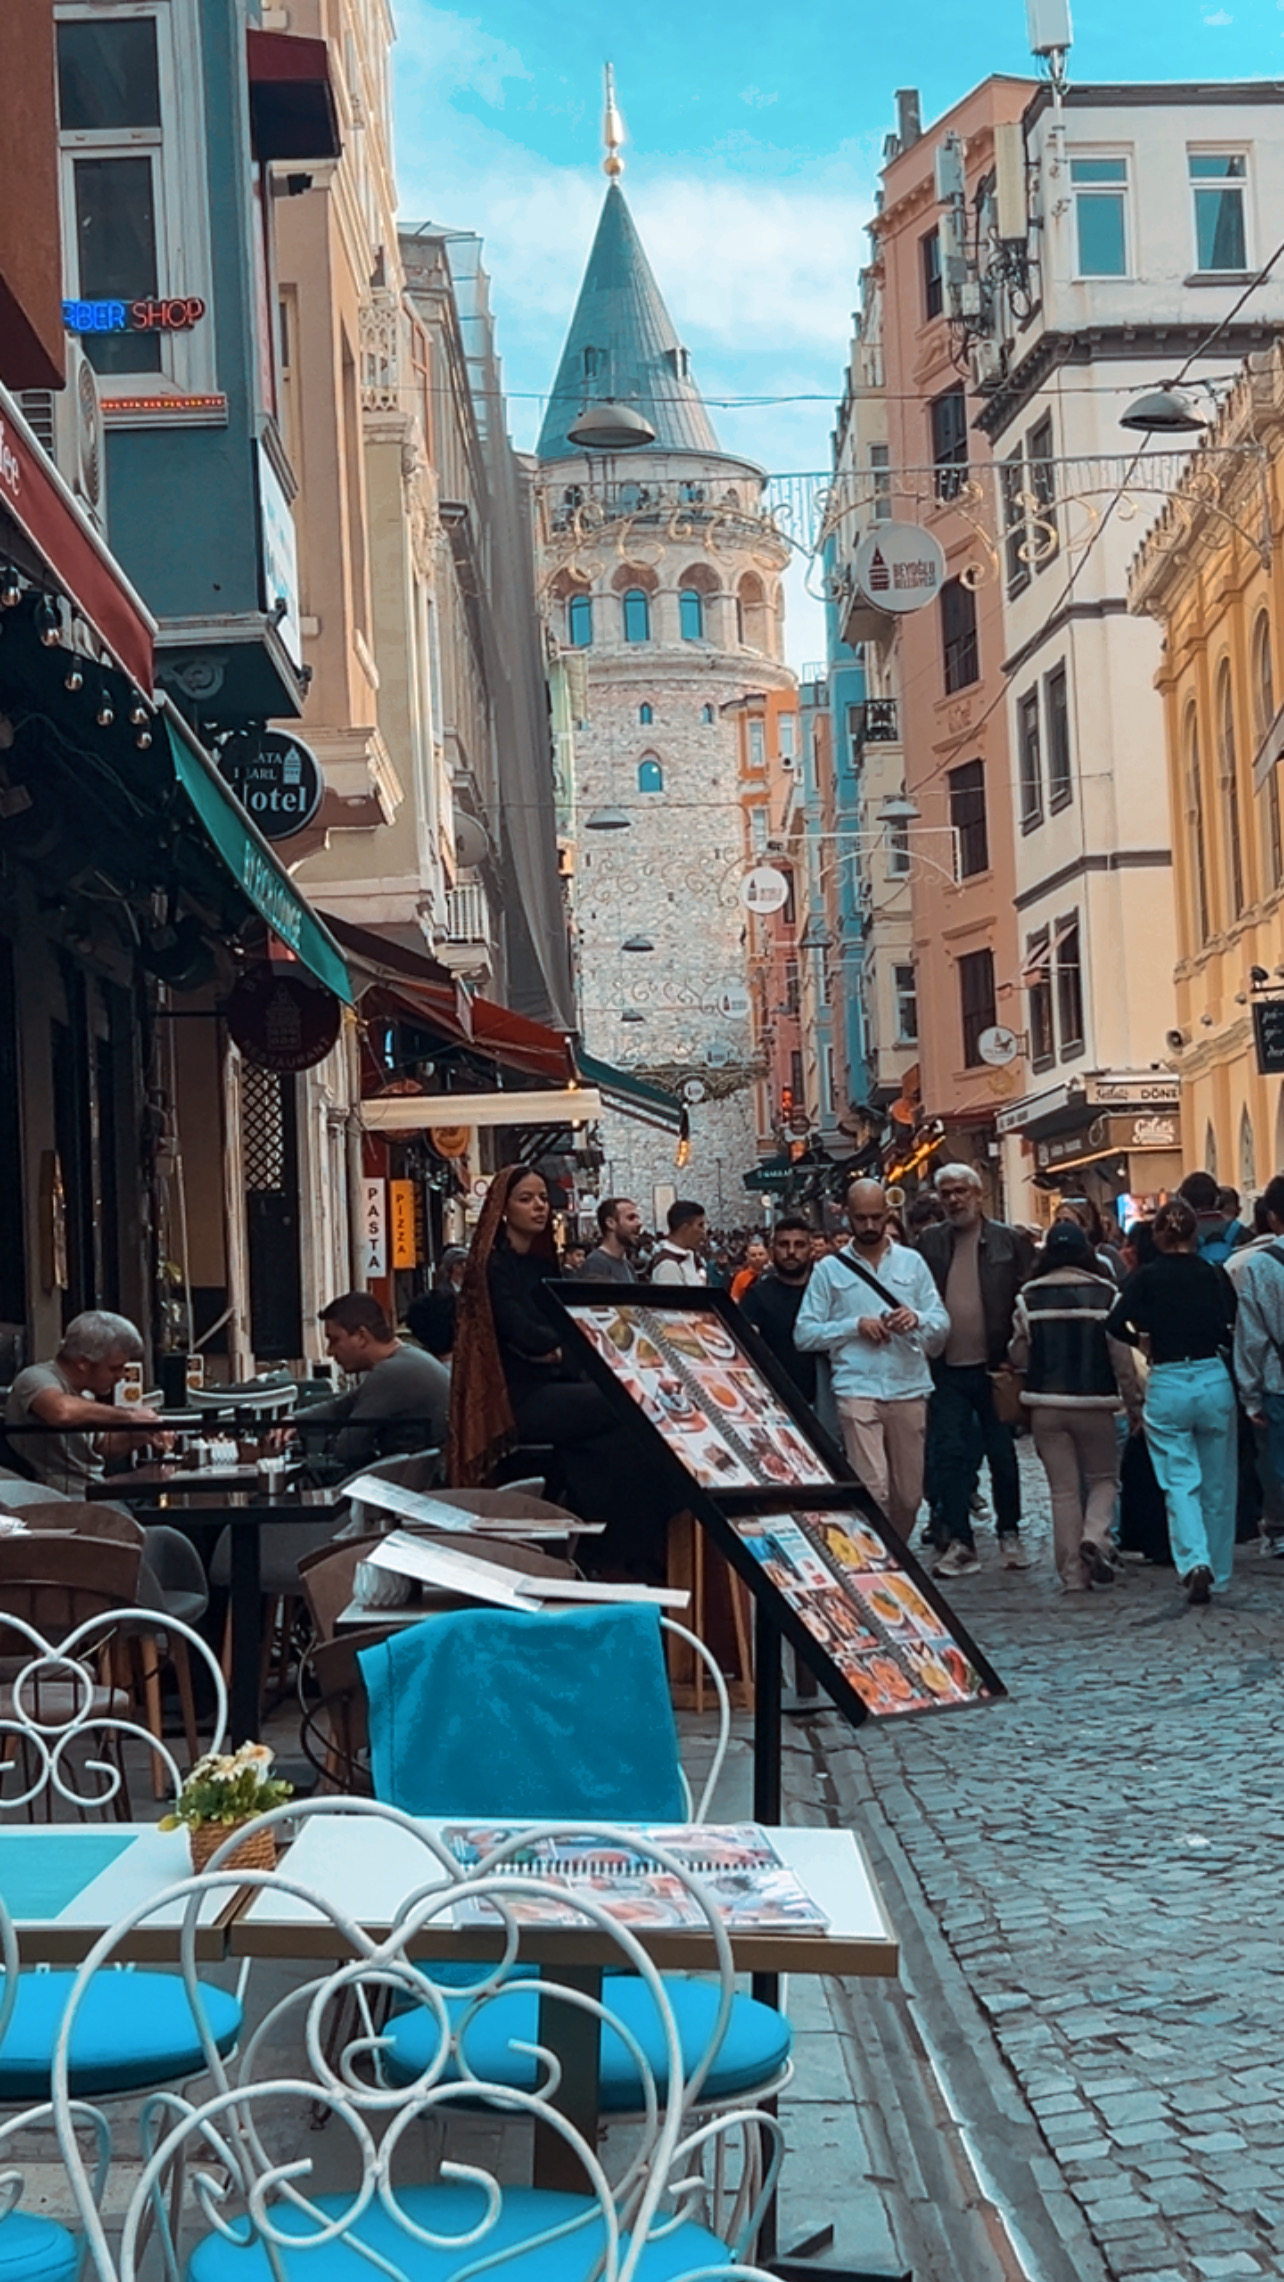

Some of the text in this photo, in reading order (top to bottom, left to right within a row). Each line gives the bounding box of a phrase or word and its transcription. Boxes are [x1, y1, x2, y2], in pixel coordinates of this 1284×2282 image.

[132, 299, 202, 328] SHOP
[893, 558, 935, 577] BEYOĞLU
[367, 1187, 380, 1268] PASTA
[395, 1194, 406, 1254] PIZZA
